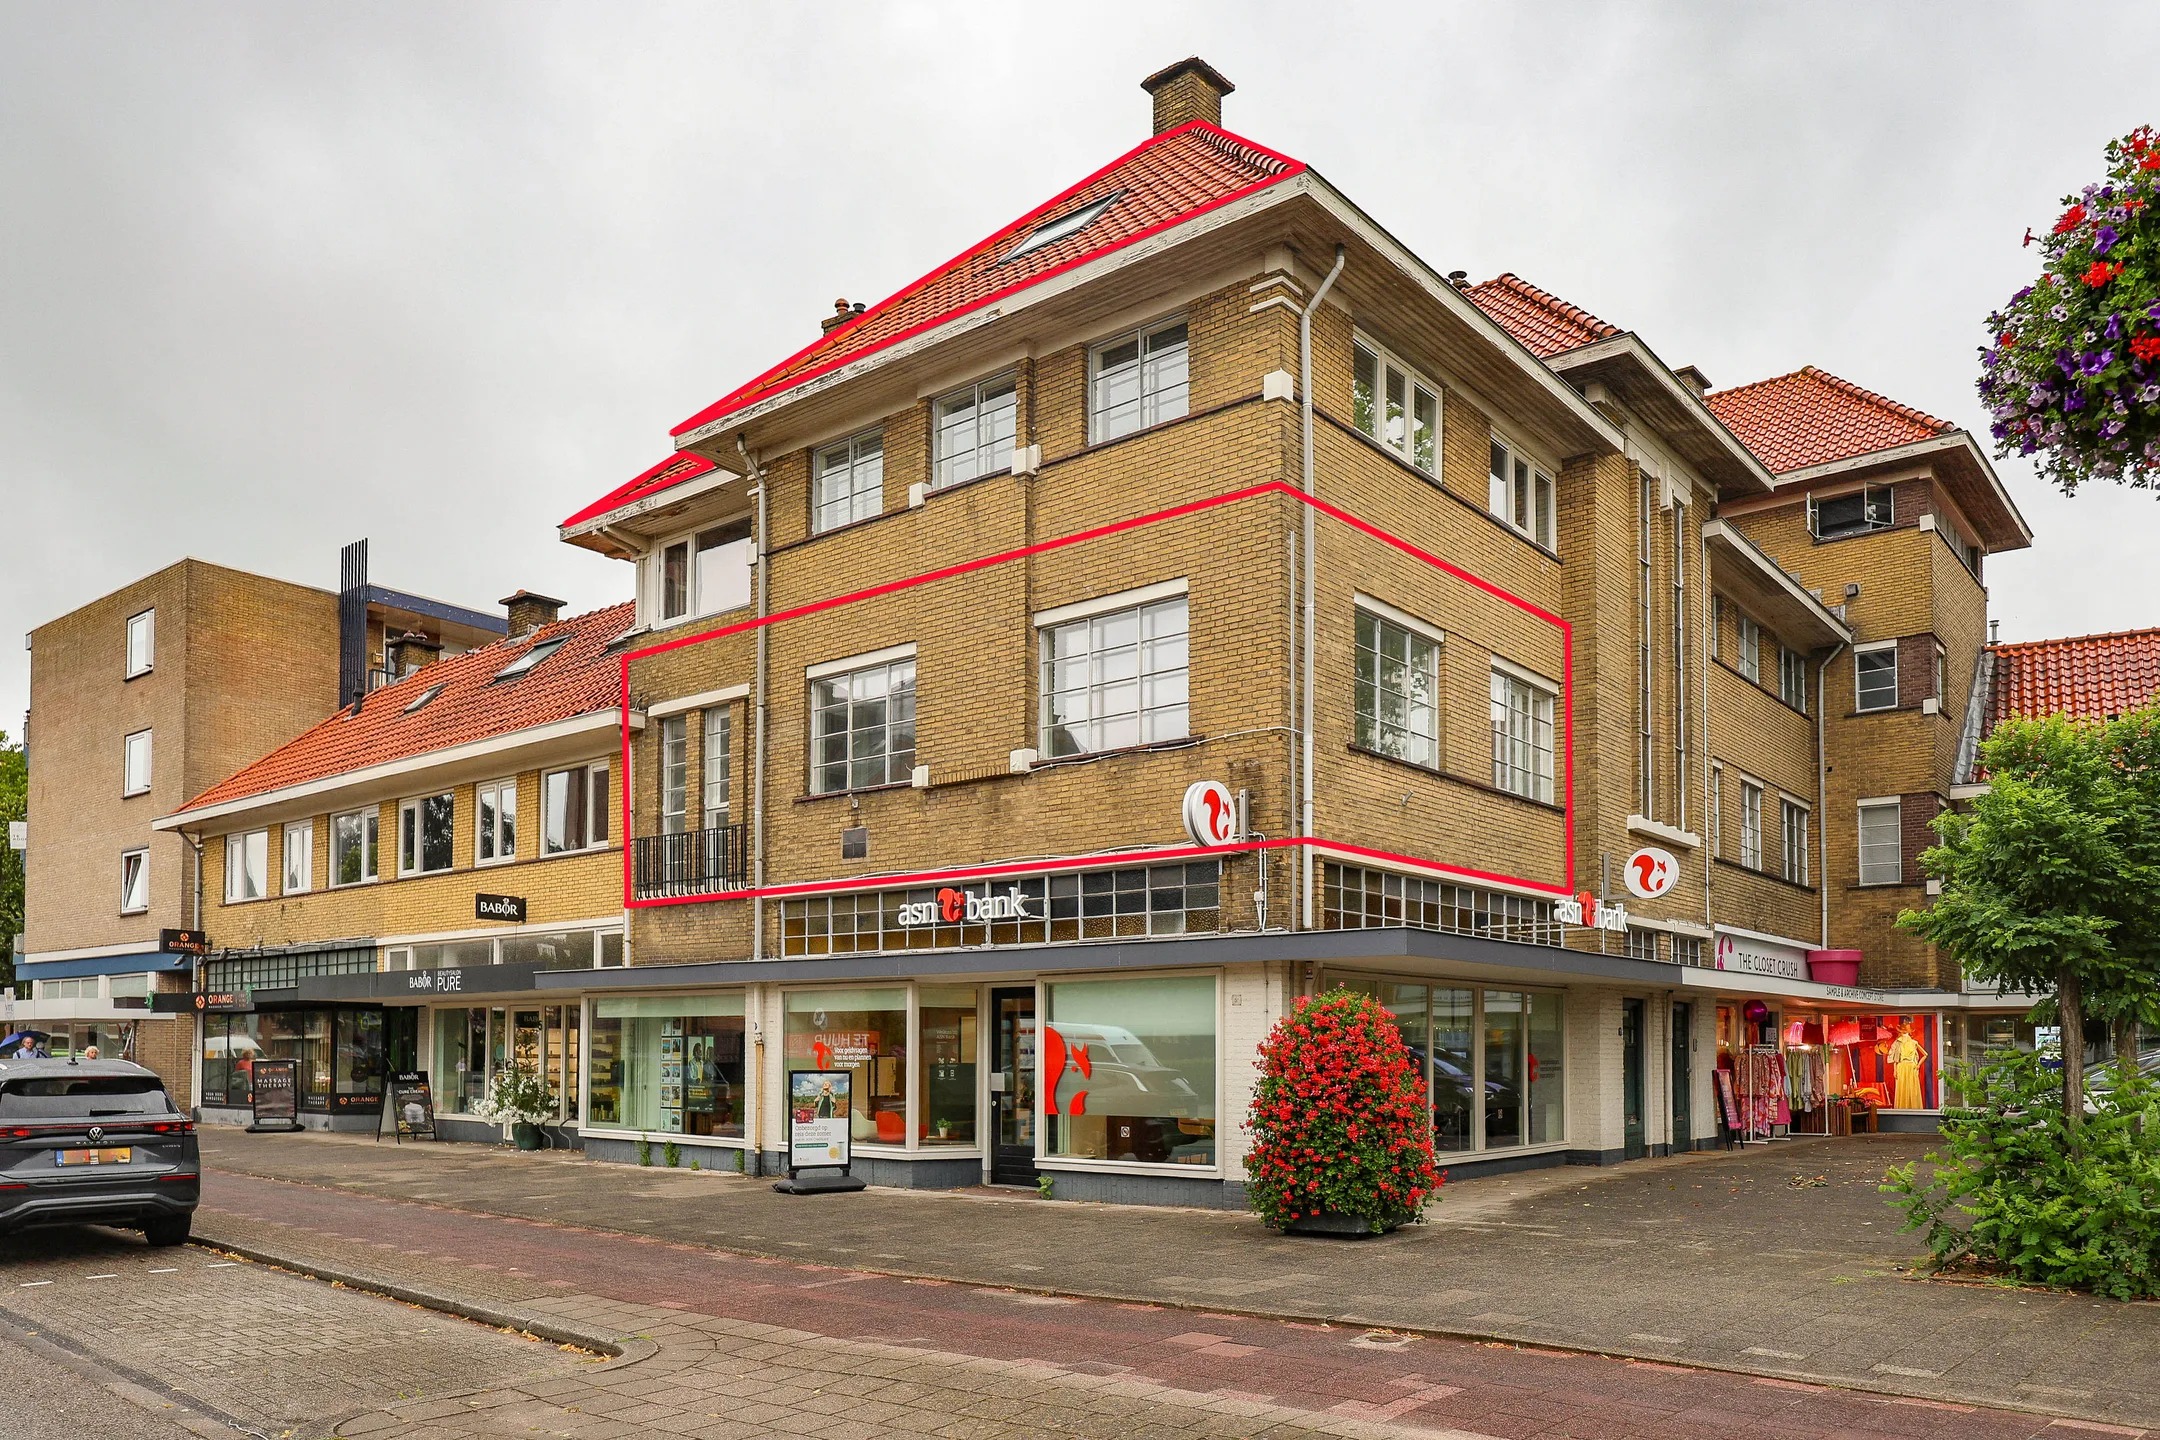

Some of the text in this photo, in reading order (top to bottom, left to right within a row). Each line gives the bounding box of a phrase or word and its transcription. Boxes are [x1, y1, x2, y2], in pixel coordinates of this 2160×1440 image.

[480, 900, 519, 917] BABOR
[897, 886, 1031, 926] asn bank
[1554, 898, 1629, 933] asn bank
[168, 941, 199, 949] ORANGE
[1738, 952, 1798, 978] THE CLOSET CRUSH
[409, 975, 432, 989] BABOR
[437, 975, 462, 992] PURE
[208, 994, 234, 1005] ORANGE
[350, 1095, 379, 1103] ORANGE
